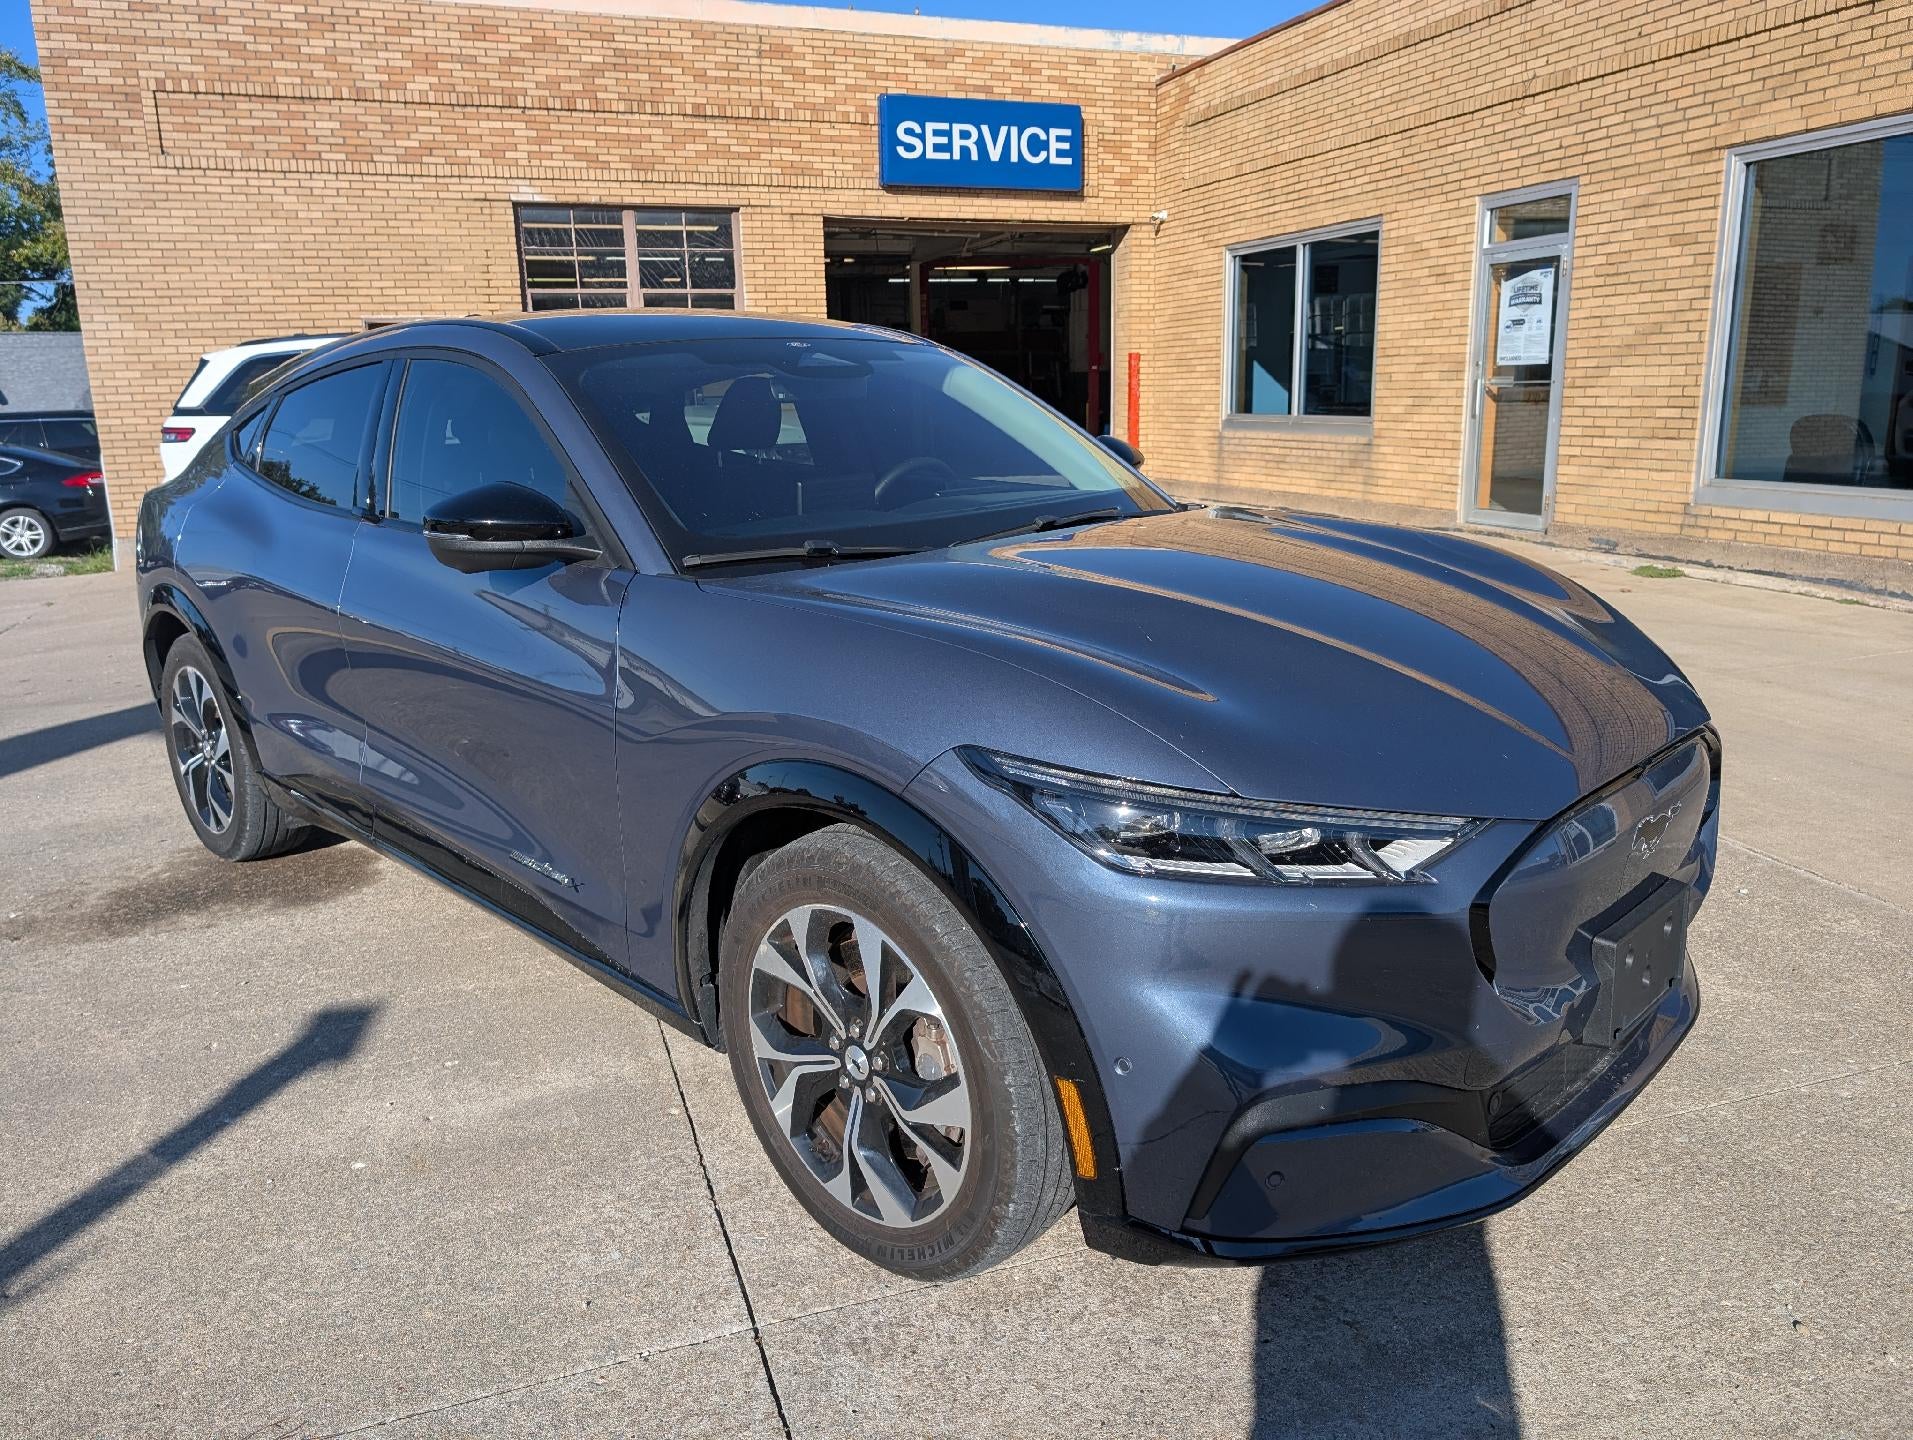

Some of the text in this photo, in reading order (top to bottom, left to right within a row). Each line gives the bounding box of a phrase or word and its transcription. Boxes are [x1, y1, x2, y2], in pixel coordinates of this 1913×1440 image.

[896, 120, 1073, 165] SERVICE
[1513, 284, 1539, 293] LIFETIME
[1511, 296, 1541, 306] WARRANTY
[876, 1233, 955, 1261] MICHELIN
